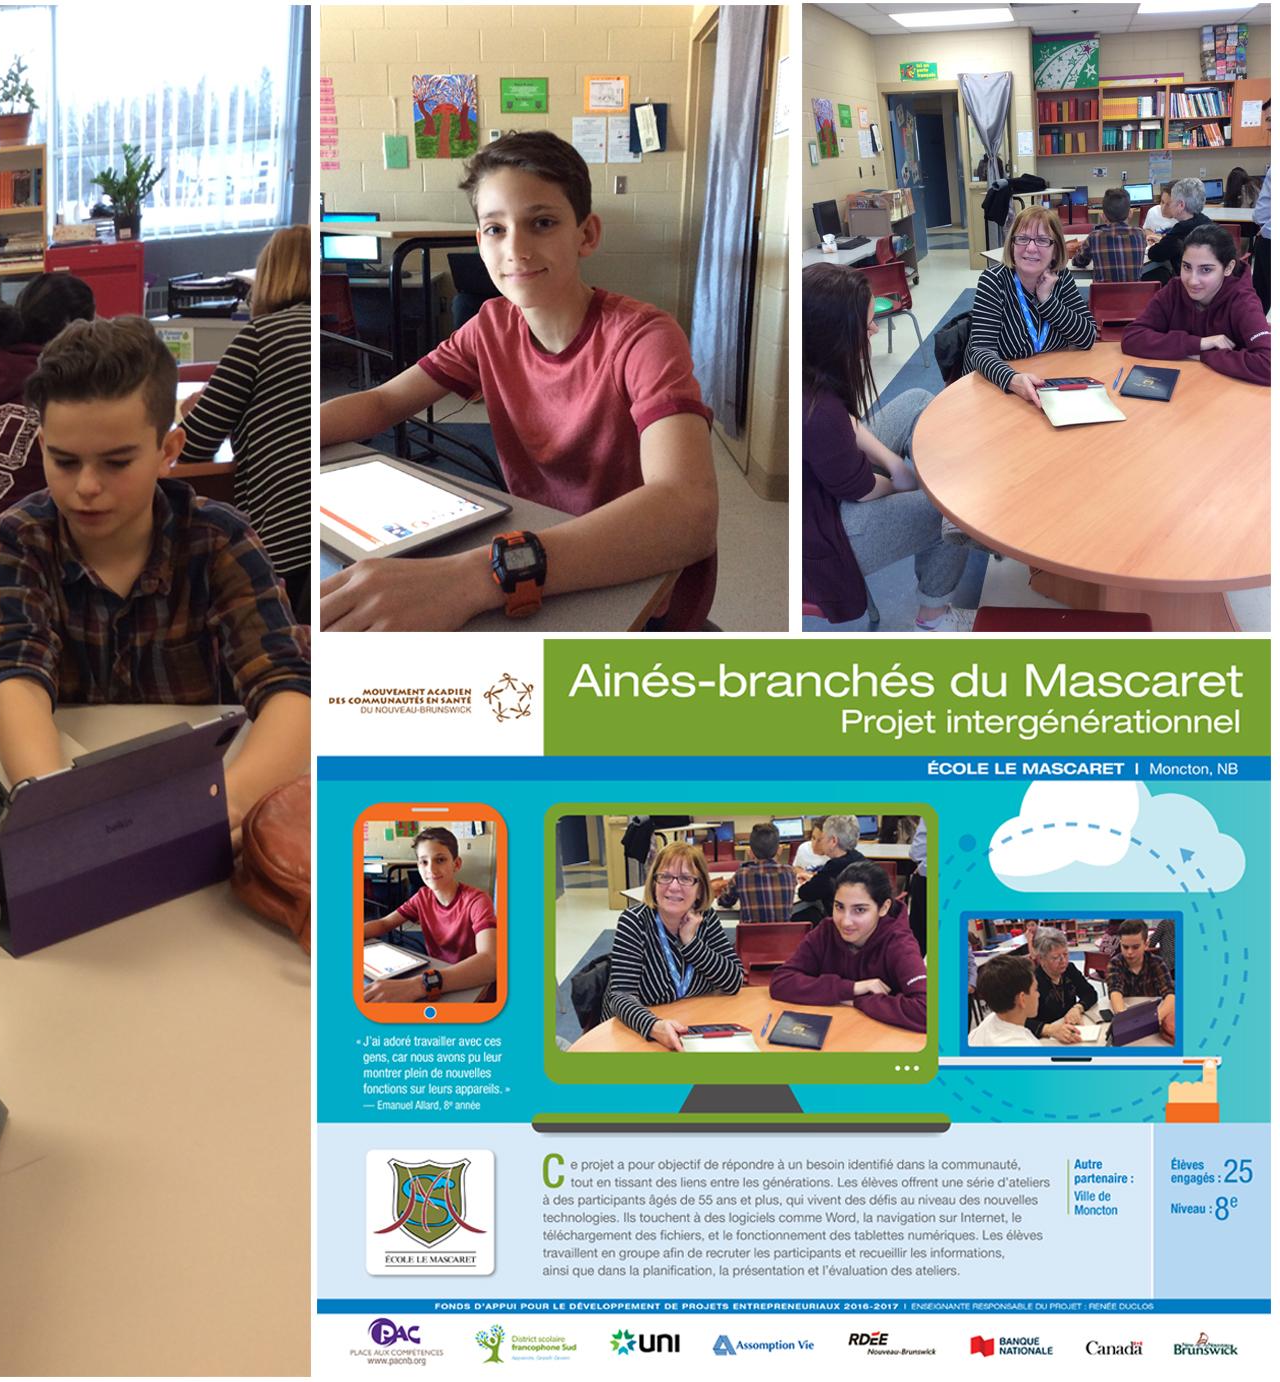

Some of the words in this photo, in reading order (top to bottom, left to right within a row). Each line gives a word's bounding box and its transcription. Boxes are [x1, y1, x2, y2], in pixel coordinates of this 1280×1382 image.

[569, 663, 934, 697] Ainés-branchés
[951, 664, 1007, 697] du
[1026, 664, 1243, 697] Mascaret
[363, 688, 425, 696] MOUVEMENT
[427, 688, 471, 696] ACADIEN
[328, 697, 346, 705] DES
[348, 695, 424, 705] COMMUNAUTÉS
[426, 697, 438, 705] EN
[440, 695, 471, 705] SANTÉ
[842, 709, 936, 739] Projet
[947, 709, 1239, 740] intergénérationnel
[928, 760, 988, 774] ÉCOLE
[995, 763, 1016, 774] LE
[1023, 763, 1124, 774] MASCARET
[1150, 763, 1212, 775] Moncton,
[1218, 763, 1238, 775] NB
[363, 1036, 380, 1046] J'ai
[384, 1036, 411, 1046] adoré
[414, 1037, 455, 1046] travailler
[459, 1038, 481, 1046] avec
[484, 1038, 501, 1046] ces
[363, 1054, 389, 1064] gens,
[392, 1054, 408, 1062] car
[411, 1054, 434, 1062] nous
[437, 1054, 465, 1062] avons
[468, 1054, 480, 1064] pu
[484, 1052, 502, 1062] leur
[364, 1068, 402, 1078] montrer
[404, 1068, 428, 1080] plein
[431, 1068, 443, 1078] de
[446, 1068, 491, 1078] nouvelles
[363, 1083, 408, 1094] fonctions
[410, 1085, 425, 1094] sur
[428, 1083, 452, 1094] leurs
[455, 1083, 502, 1097] appareils.
[377, 1100, 413, 1110] Emanuel
[415, 1100, 441, 1110] Allard,
[455, 1101, 480, 1110] année
[581, 1160, 614, 1172] projet
[628, 1161, 655, 1172] pour
[658, 1159, 701, 1172] objectif
[704, 1160, 719, 1170] de
[722, 1159, 774, 1172] répondre
[778, 1159, 785, 1170] à
[788, 1161, 802, 1170] un
[806, 1160, 844, 1170] besoin
[848, 1159, 893, 1170] identifié
[897, 1160, 925, 1170] dans
[929, 1160, 938, 1170] la
[941, 1159, 1021, 1170] communauté,
[1074, 1159, 1102, 1169] Autre
[1171, 1157, 1204, 1170] Élèves
[1224, 1159, 1253, 1183] 25
[571, 1178, 593, 1187] tout
[597, 1179, 611, 1187] en
[615, 1177, 652, 1187] tissant
[656, 1177, 677, 1187] des
[681, 1177, 707, 1188] liens
[710, 1178, 739, 1187] entre
[743, 1177, 759, 1188] les
[763, 1177, 833, 1190] générations.
[838, 1177, 858, 1187] Les
[861, 1177, 898, 1188] élèves
[901, 1177, 938, 1188] offrent
[942, 1179, 963, 1187] une
[967, 1177, 994, 1187] série
[997, 1177, 1050, 1187] d'ateliers
[1074, 1173, 1127, 1185] partenaire
[1171, 1172, 1215, 1185] engagés
[1074, 1191, 1095, 1201] Ville
[1098, 1191, 1111, 1201] de
[1074, 1205, 1118, 1215] Moncton
[1171, 1203, 1205, 1214] Niveau
[385, 1254, 414, 1264] ÉCOLE
[416, 1256, 427, 1264] LE
[429, 1256, 477, 1264] MASCARET
[543, 1265, 569, 1276] ainsi
[572, 1267, 594, 1278] que
[598, 1265, 626, 1276] dans
[630, 1265, 639, 1276] la
[643, 1265, 715, 1278] planification,
[719, 1265, 729, 1276] la
[733, 1265, 804, 1278] présentation
[808, 1266, 819, 1276] et
[823, 1265, 887, 1276] l'évaluation
[891, 1265, 912, 1276] des
[915, 1265, 960, 1276] ateliers.
[849, 1332, 888, 1345] RDÉE
[1000, 1337, 1039, 1345] BANQUE
[511, 1343, 560, 1352] francophone
[561, 1343, 577, 1352] Sud
[735, 1340, 796, 1353] Assomption
[797, 1340, 816, 1351] Vie
[1000, 1347, 1052, 1355] NATIONALE
[1086, 1341, 1142, 1355] Canada
[1173, 1343, 1238, 1356] Brunswick
[350, 1349, 372, 1357] PLACE
[374, 1349, 389, 1357] AUX
[367, 1357, 426, 1366] www.pacnb.org
